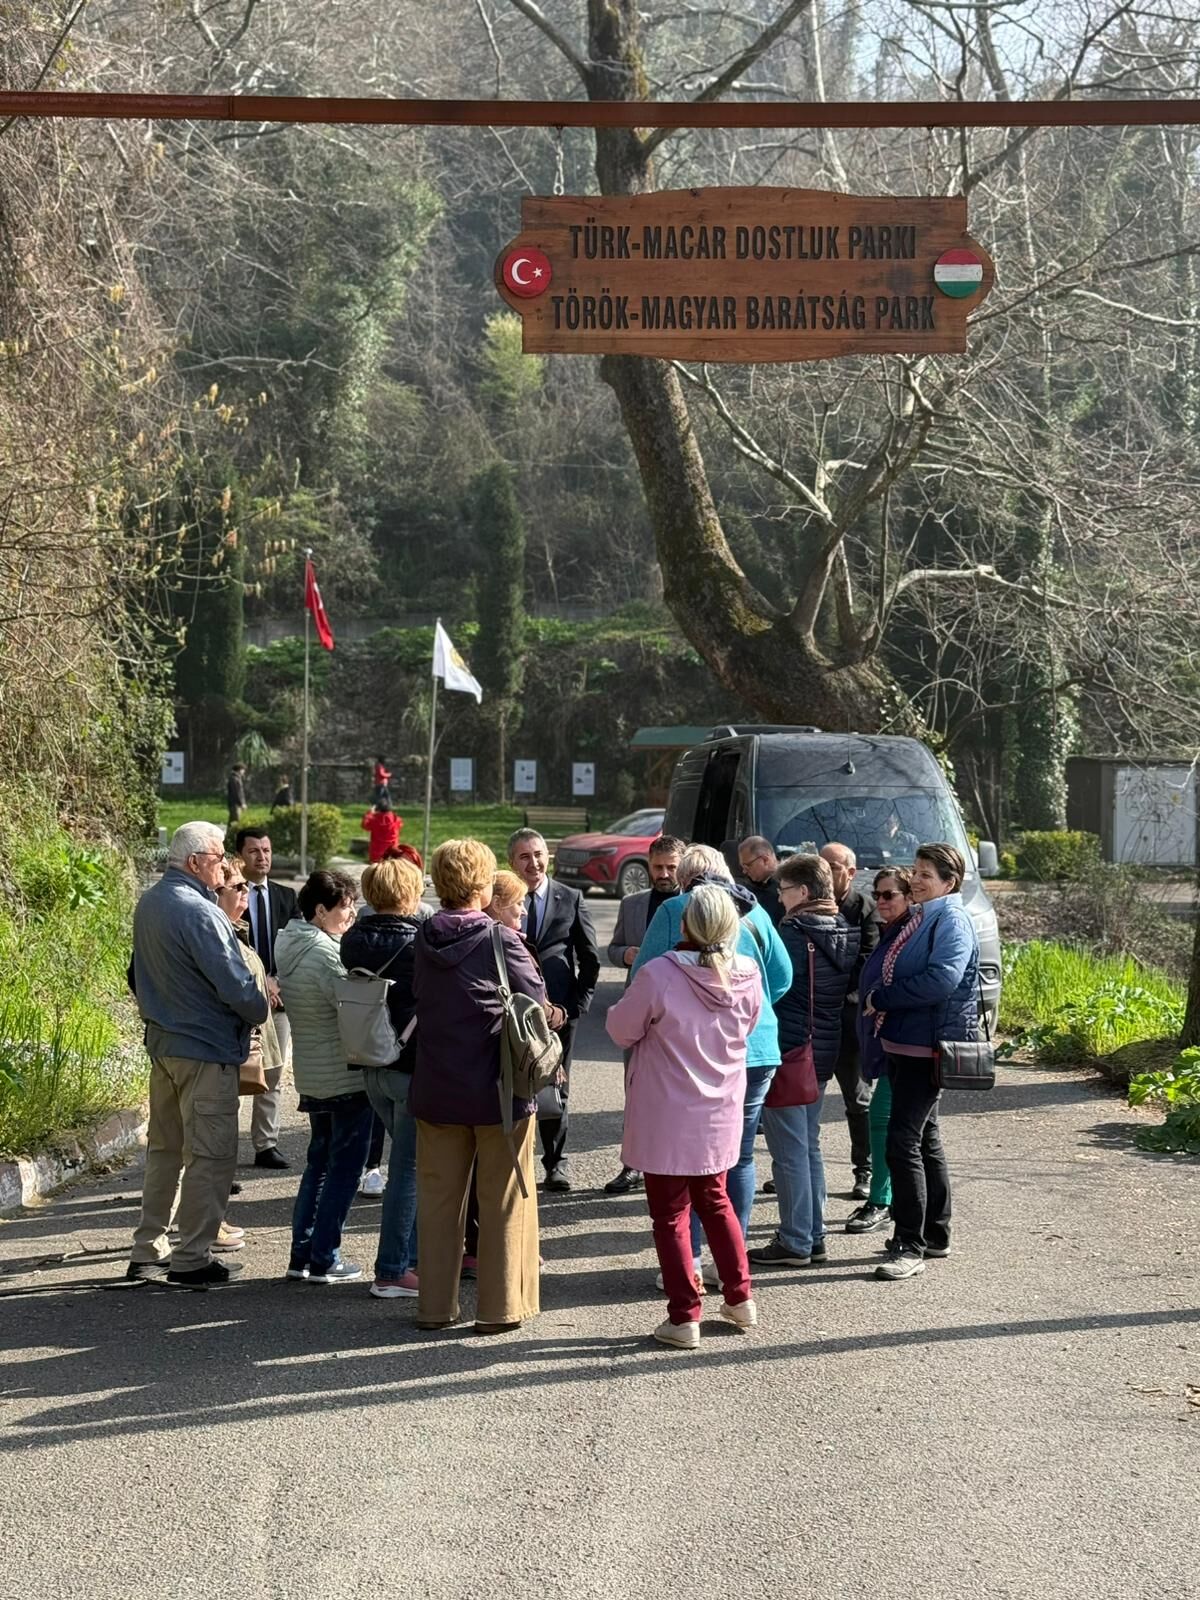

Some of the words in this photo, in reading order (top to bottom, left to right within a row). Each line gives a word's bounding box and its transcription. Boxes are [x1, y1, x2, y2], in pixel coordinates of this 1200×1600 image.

[569, 217, 726, 260] TÜRK-MACAR
[735, 225, 839, 260] DOSTLUK
[849, 225, 916, 259] PARKI
[551, 288, 737, 330] TÖRÖK-MAGYAR
[746, 289, 865, 330] BARÁTSÁG
[875, 296, 935, 330] PARK
